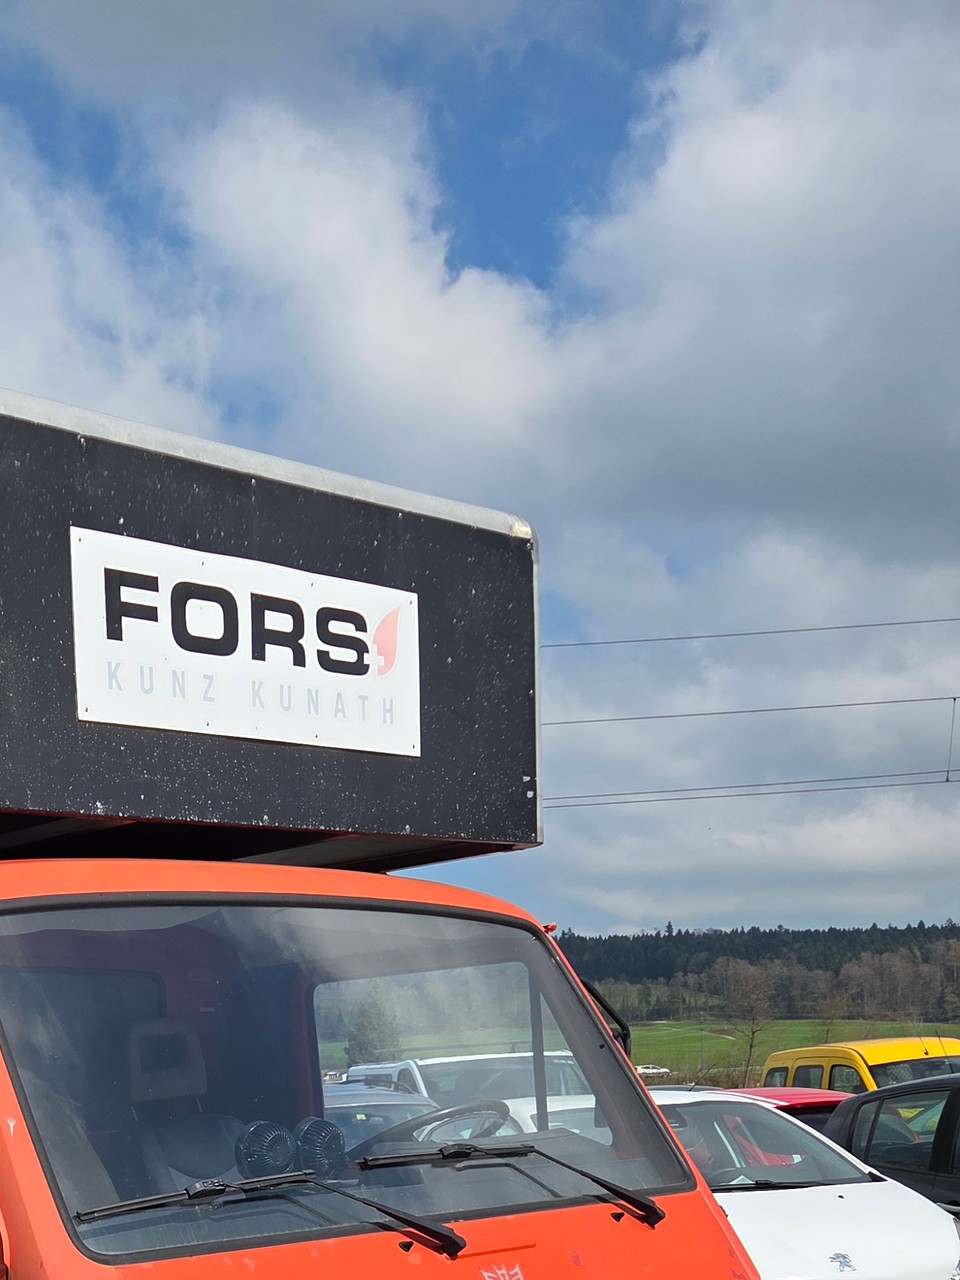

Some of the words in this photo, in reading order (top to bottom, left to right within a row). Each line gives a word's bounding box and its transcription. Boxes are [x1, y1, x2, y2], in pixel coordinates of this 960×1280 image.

[104, 566, 370, 676] FORS
[106, 660, 216, 703] KUNZ
[250, 679, 396, 726] KUNATH
